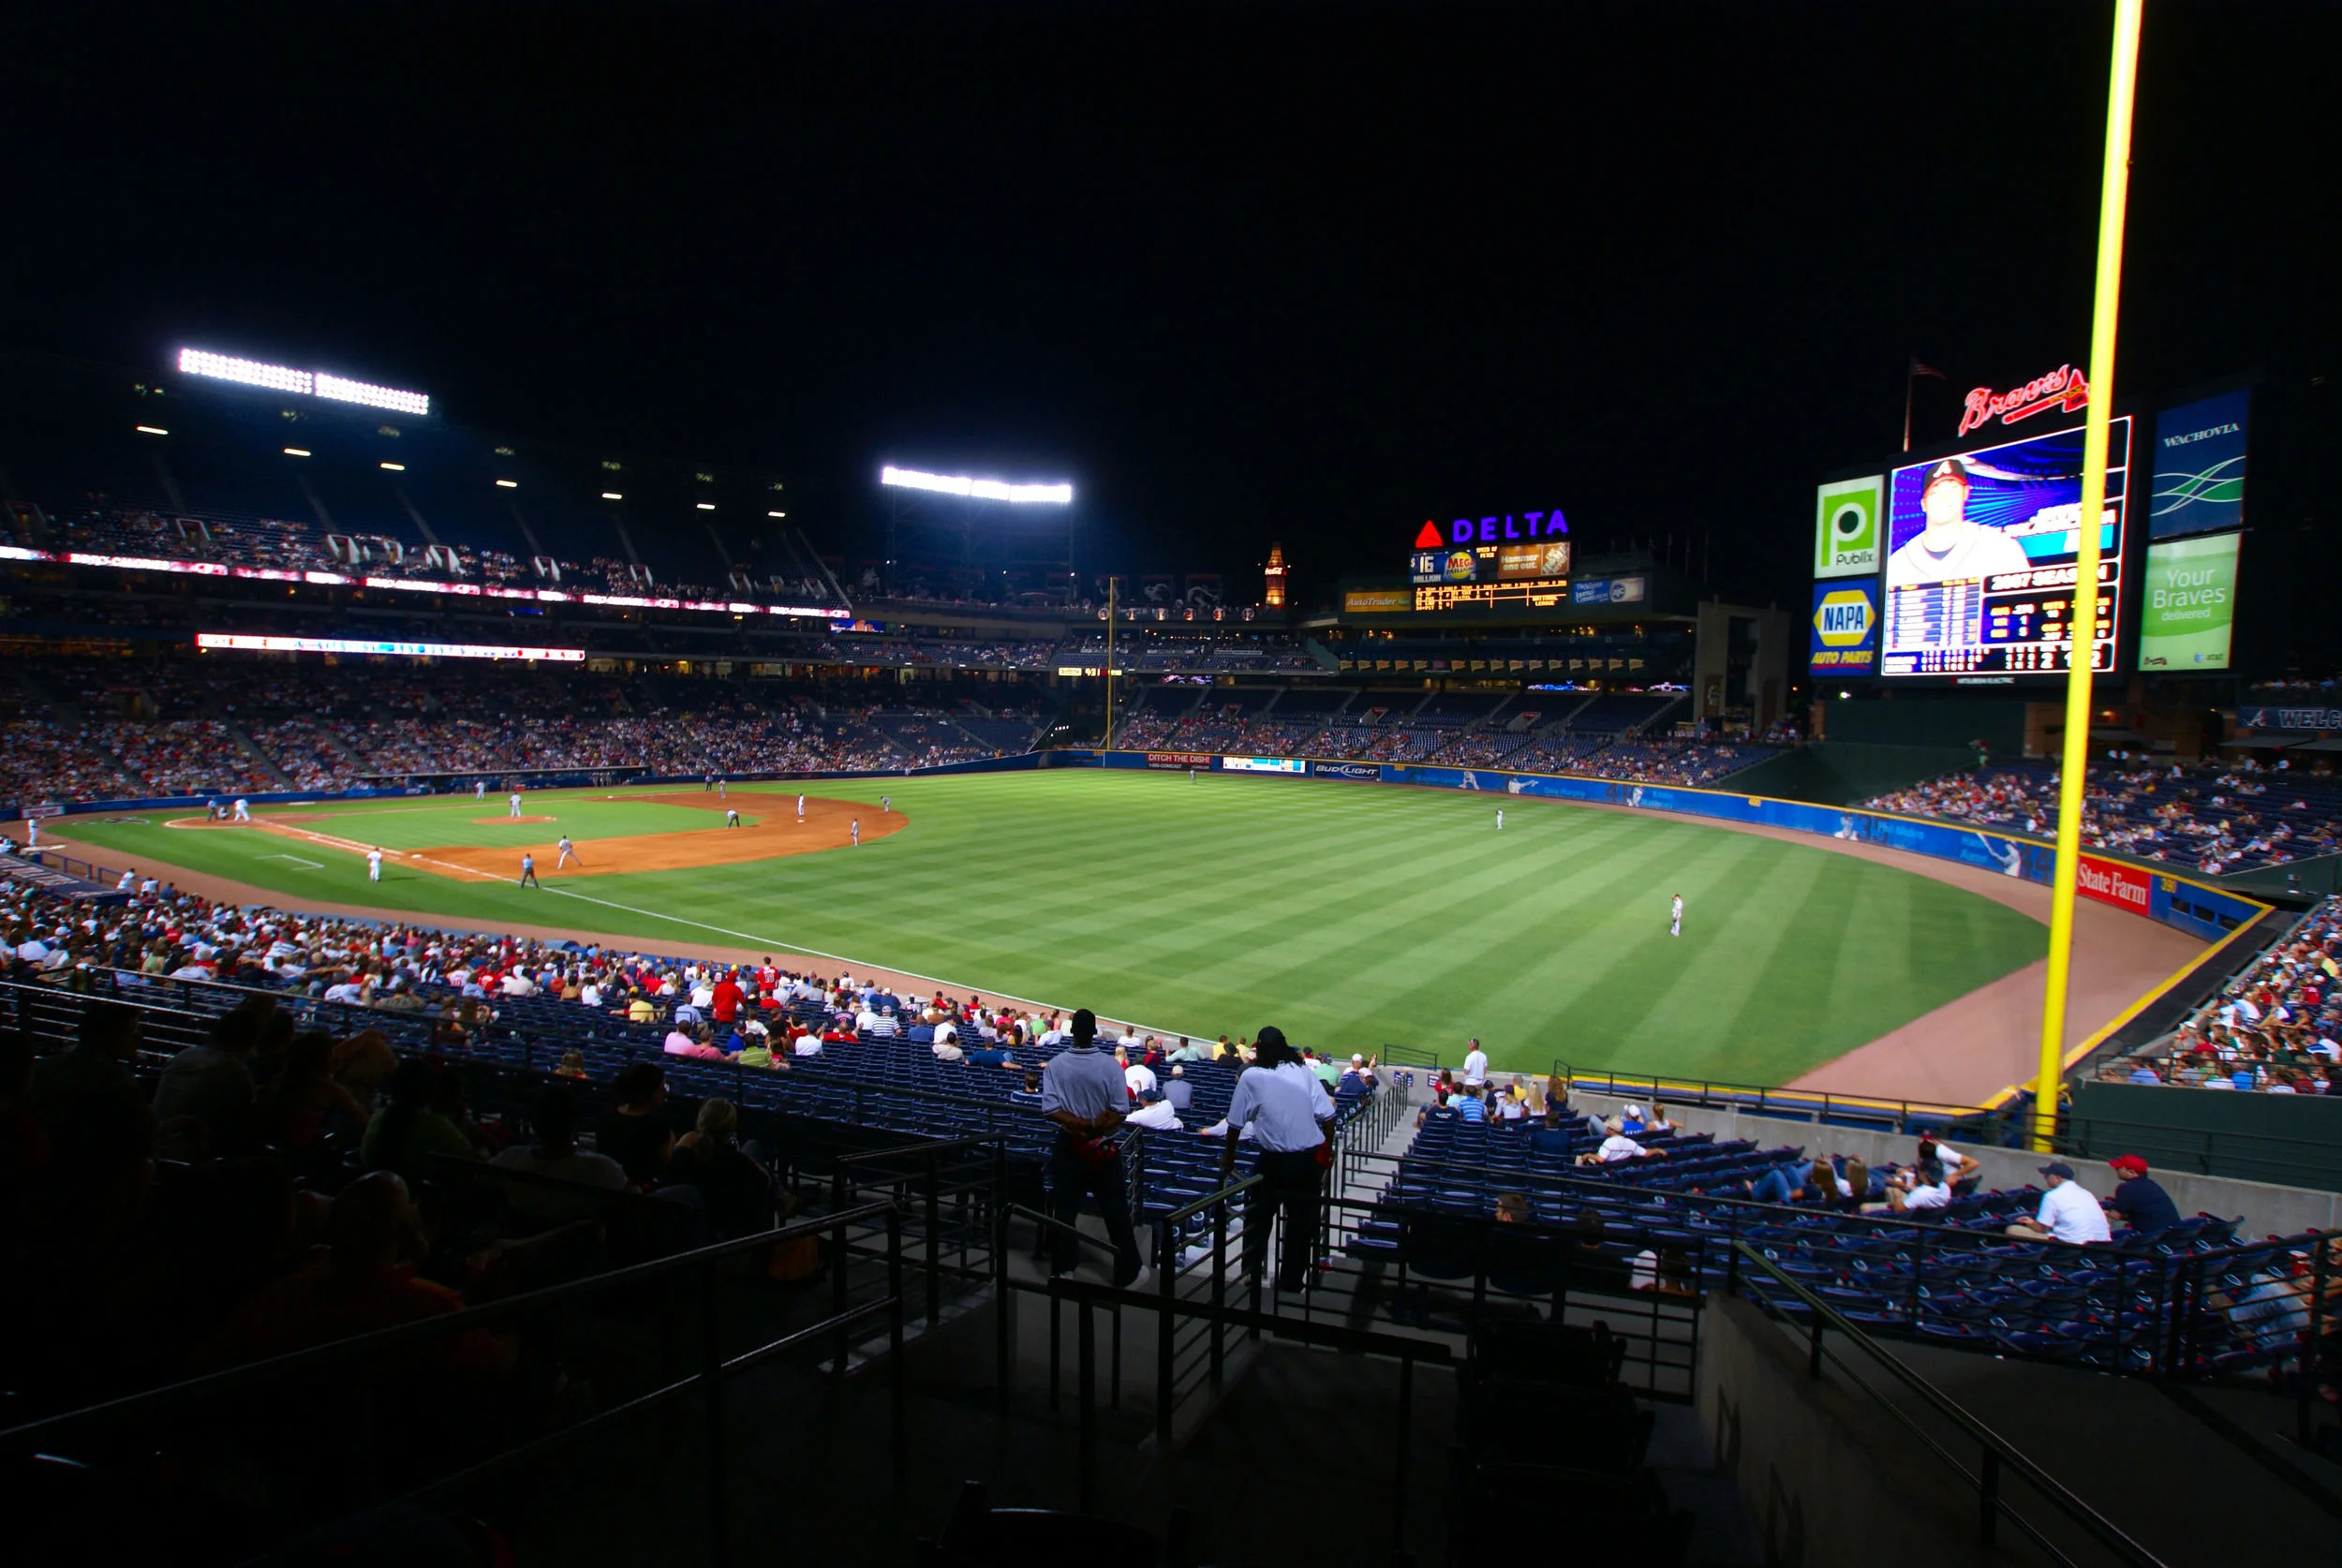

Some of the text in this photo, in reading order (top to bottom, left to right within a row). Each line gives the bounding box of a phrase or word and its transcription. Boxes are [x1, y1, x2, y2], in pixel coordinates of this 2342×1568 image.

[1958, 363, 2070, 437] Braves
[2163, 422, 2240, 448] WACHOVIA
[1453, 510, 1568, 542] DELTA
[1419, 555, 1434, 573] 16
[1447, 557, 1475, 569] MEGA
[1501, 555, 1538, 564] Hammer
[2166, 569, 2216, 588] Your
[2153, 587, 2226, 609] Braves
[1824, 604, 1864, 631] NAPA
[2161, 607, 2211, 621] delivered
[1812, 652, 1839, 664] AUTO
[1841, 651, 1873, 664] PARTS
[2040, 652, 2053, 670] 2
[2278, 709, 2342, 730] WELC
[2080, 864, 2147, 906] State Farm
